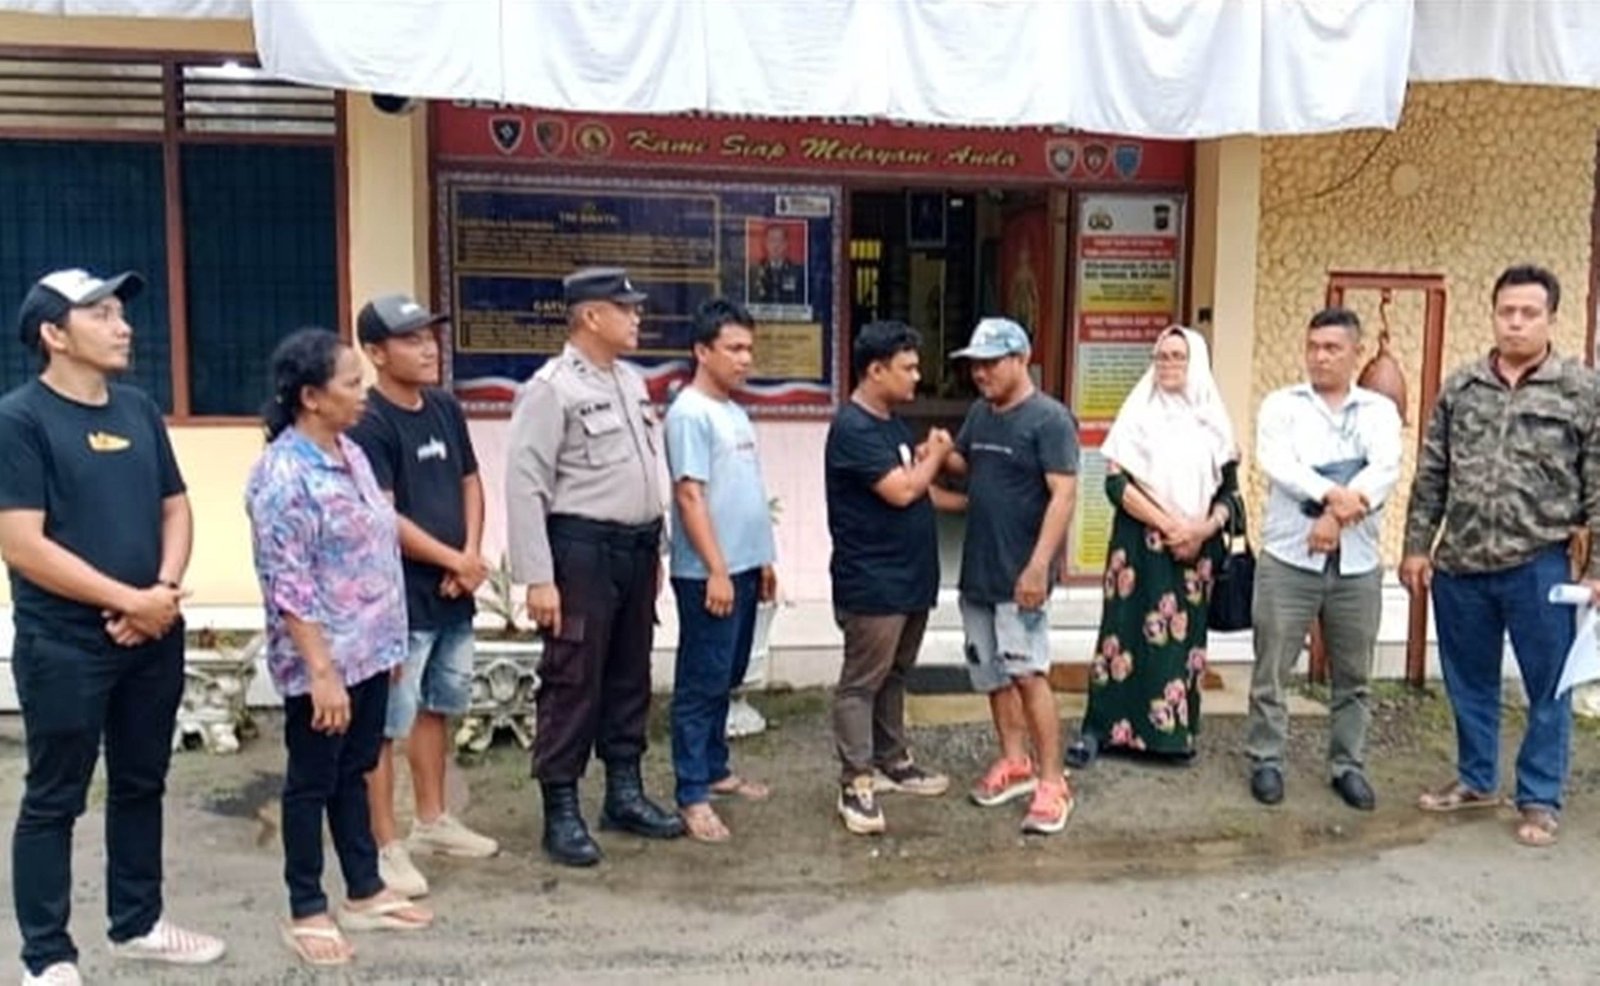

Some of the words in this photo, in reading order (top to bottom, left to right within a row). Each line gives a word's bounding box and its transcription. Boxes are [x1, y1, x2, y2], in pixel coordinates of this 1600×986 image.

[627, 130, 706, 155] Kami
[721, 134, 787, 160] Siap
[800, 138, 931, 166] Melayani
[943, 144, 1019, 168] Anda
